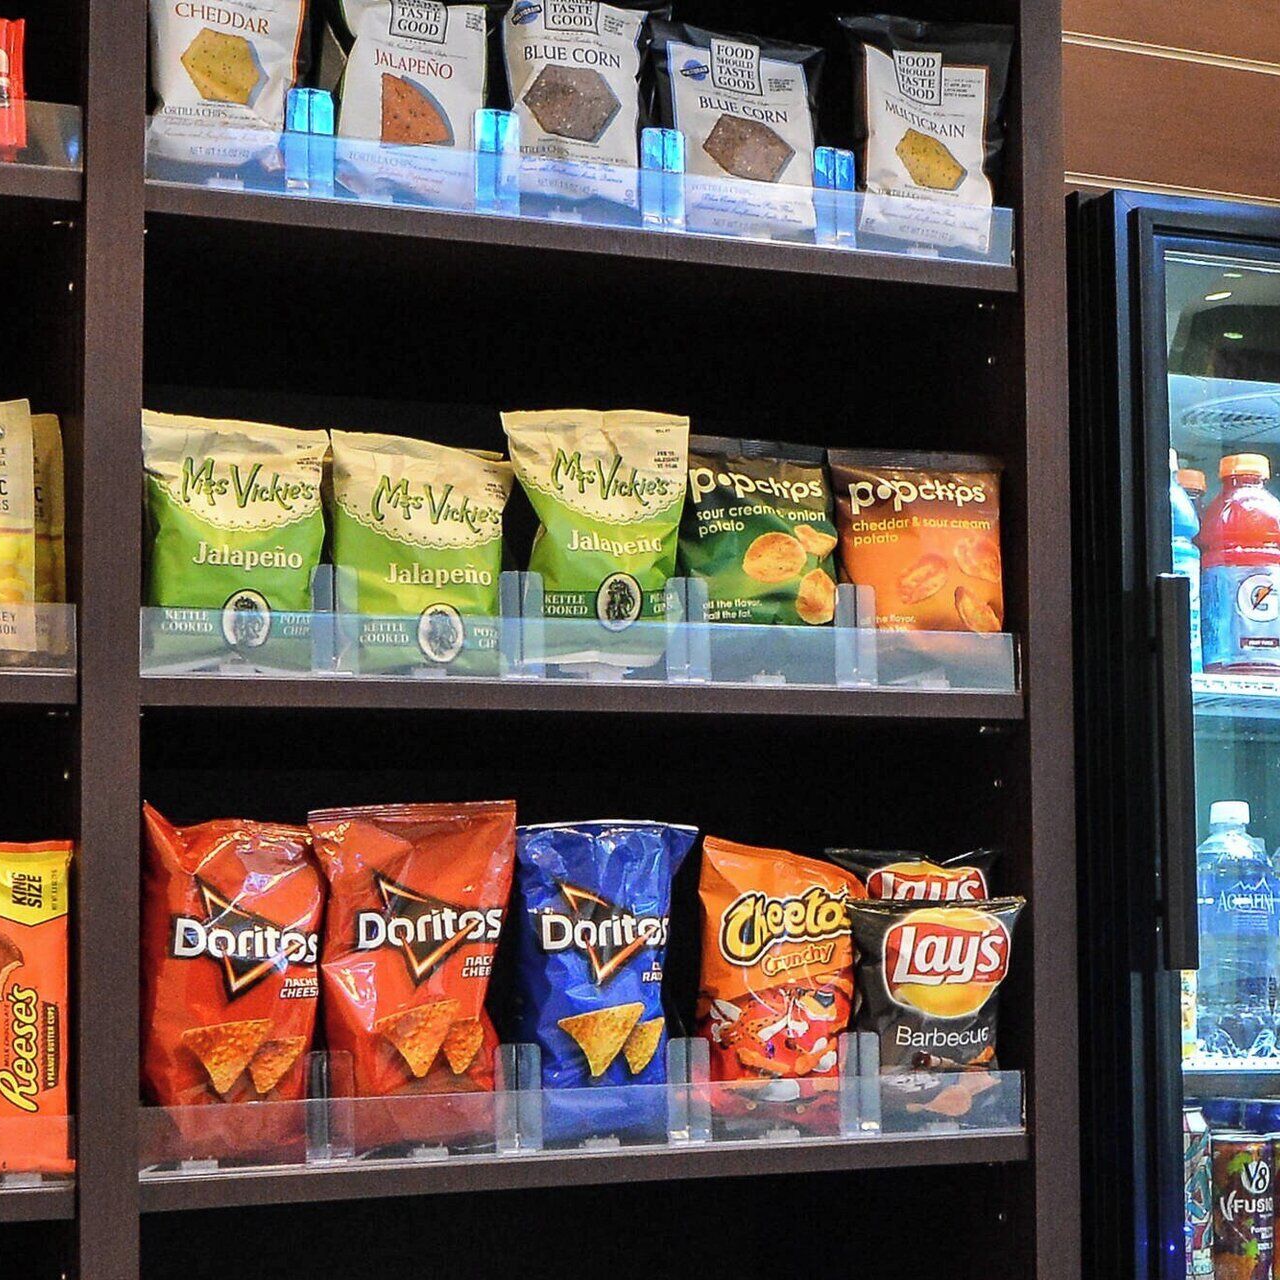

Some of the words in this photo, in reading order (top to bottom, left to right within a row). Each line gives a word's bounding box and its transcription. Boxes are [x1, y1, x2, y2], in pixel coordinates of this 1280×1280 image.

[175, 2, 270, 35] CHEDDAR
[397, 19, 439, 36] GOOD
[398, 5, 441, 23] TASTE
[551, 14, 594, 29] GOOD
[374, 48, 453, 80] JALAPEÑO
[522, 45, 567, 61] BLUE
[573, 47, 621, 69] CORN
[716, 43, 754, 60] FOOD
[717, 55, 754, 70] SHOULD
[898, 55, 936, 70] FOOD
[717, 66, 755, 82] TASTE
[717, 77, 757, 92] GOOD
[899, 66, 936, 80] SHOULD
[902, 87, 935, 101] GOOD
[699, 96, 740, 113] BLUE
[742, 106, 789, 124] CORN
[885, 101, 966, 137] MULTIGRAIN
[230, 461, 315, 510] Vickie's
[596, 454, 672, 507] Vickie's
[689, 466, 822, 504] popchips
[423, 483, 501, 533] Vickie's
[849, 478, 987, 515] popchips
[852, 517, 908, 532] cheddar
[193, 541, 303, 572] Jalapeño
[567, 530, 662, 557] Jalapeño
[385, 563, 492, 587] Jalapeño
[161, 621, 213, 633] COOKED
[165, 609, 210, 622] KETTLE
[12, 873, 26, 905] KING
[27, 875, 42, 909] SIZE
[174, 917, 317, 961] Doritos
[358, 907, 503, 951] Doritos
[541, 913, 670, 951] Doritos
[762, 941, 836, 977] Crunchy
[890, 926, 1007, 986] Lay's
[896, 1025, 990, 1049] Barbecue
[1243, 1159, 1267, 1191] V8
